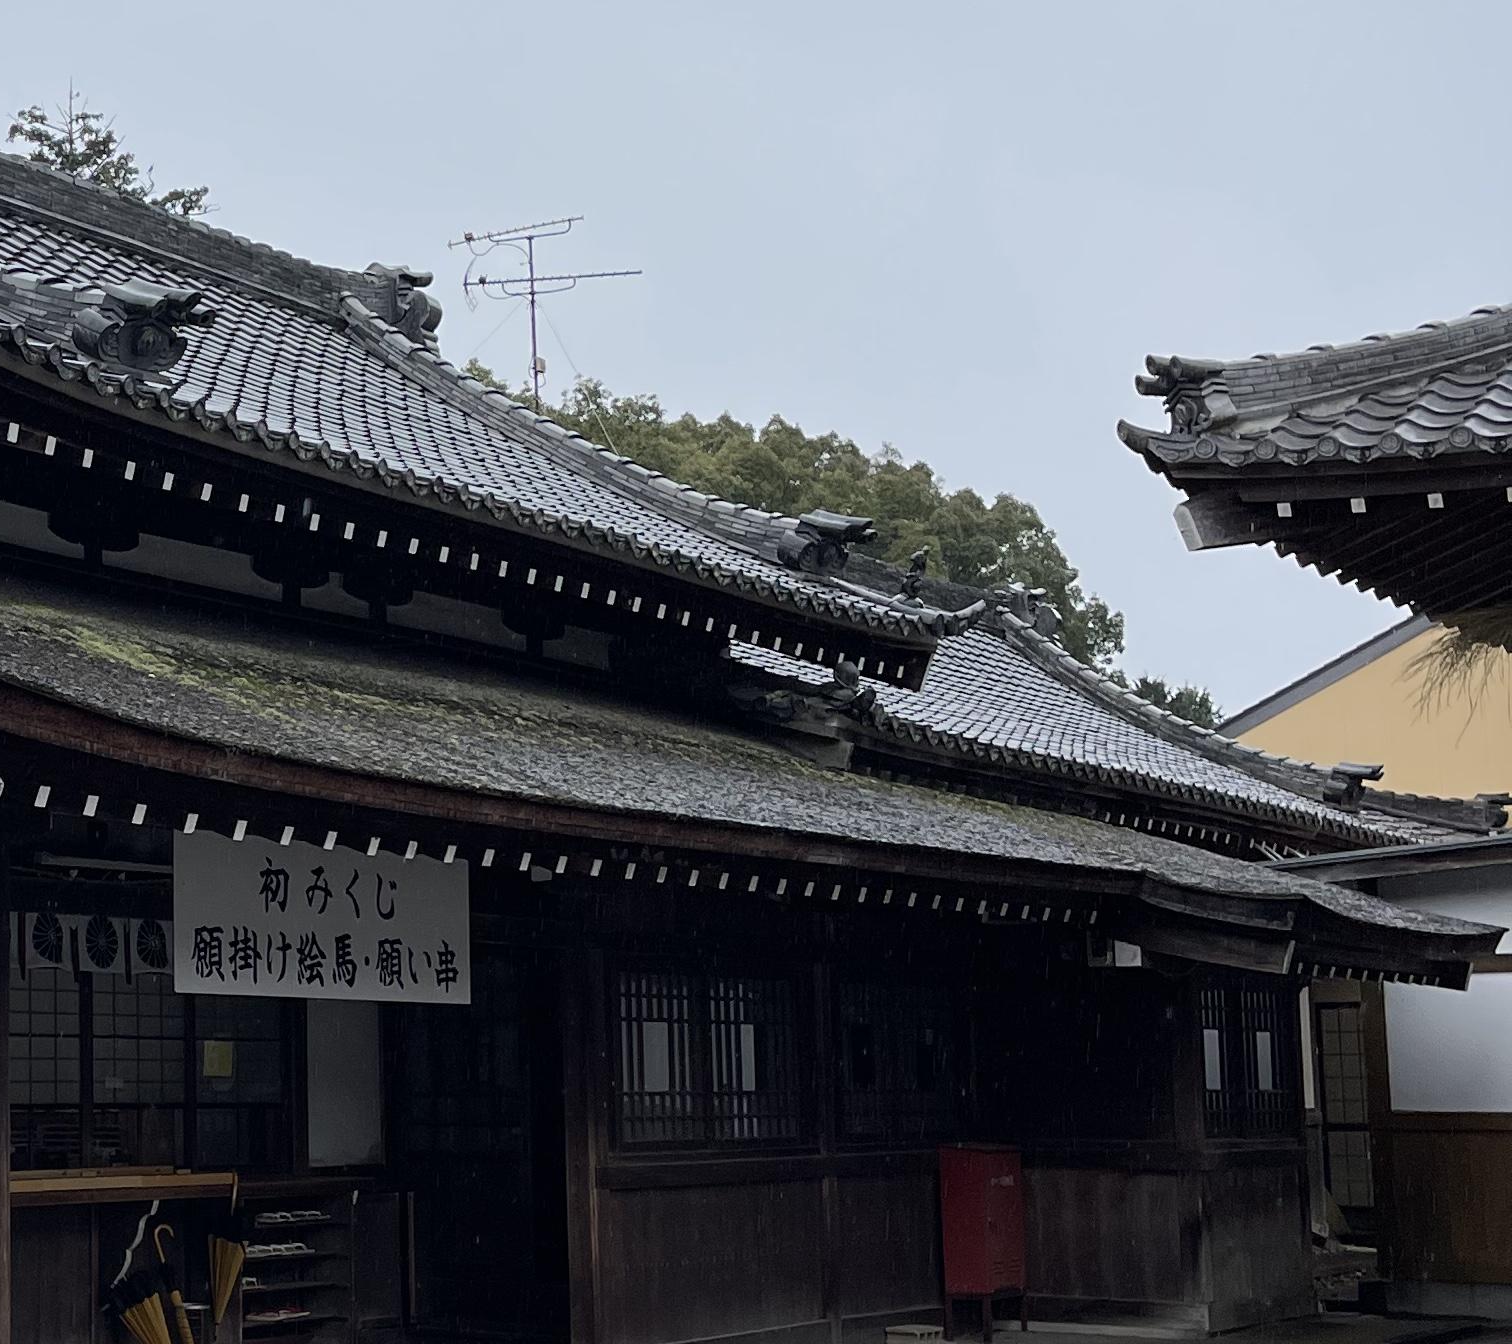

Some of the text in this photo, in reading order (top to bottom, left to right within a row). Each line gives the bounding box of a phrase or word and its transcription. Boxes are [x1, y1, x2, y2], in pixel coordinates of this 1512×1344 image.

[259, 857, 398, 921] 初みくじ
[191, 925, 460, 994] 願掛け絵馬・願い串
